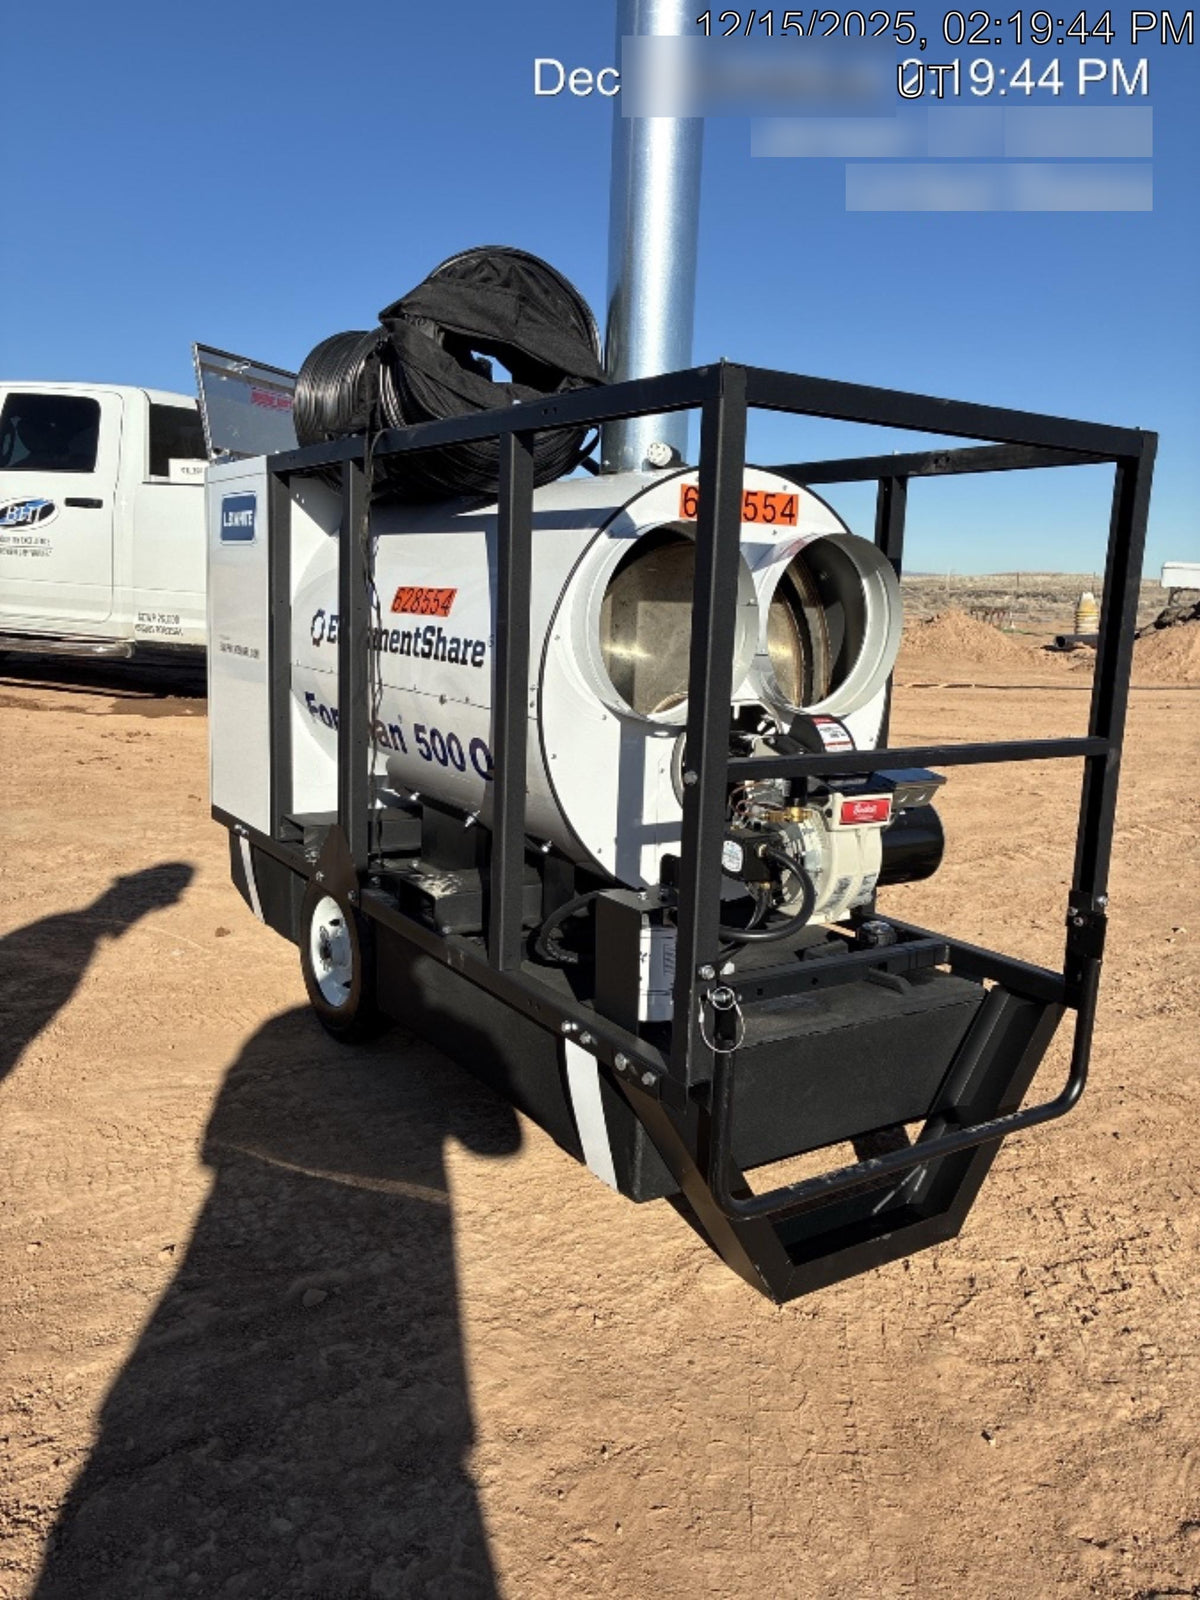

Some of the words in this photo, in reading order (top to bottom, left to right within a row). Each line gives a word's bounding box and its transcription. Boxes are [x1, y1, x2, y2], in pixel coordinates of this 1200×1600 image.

[682, 485, 796, 525] 6554
[392, 587, 456, 616] 628554
[327, 614, 487, 669] EmentShare
[305, 691, 408, 754] Foran
[414, 723, 466, 772] 500
